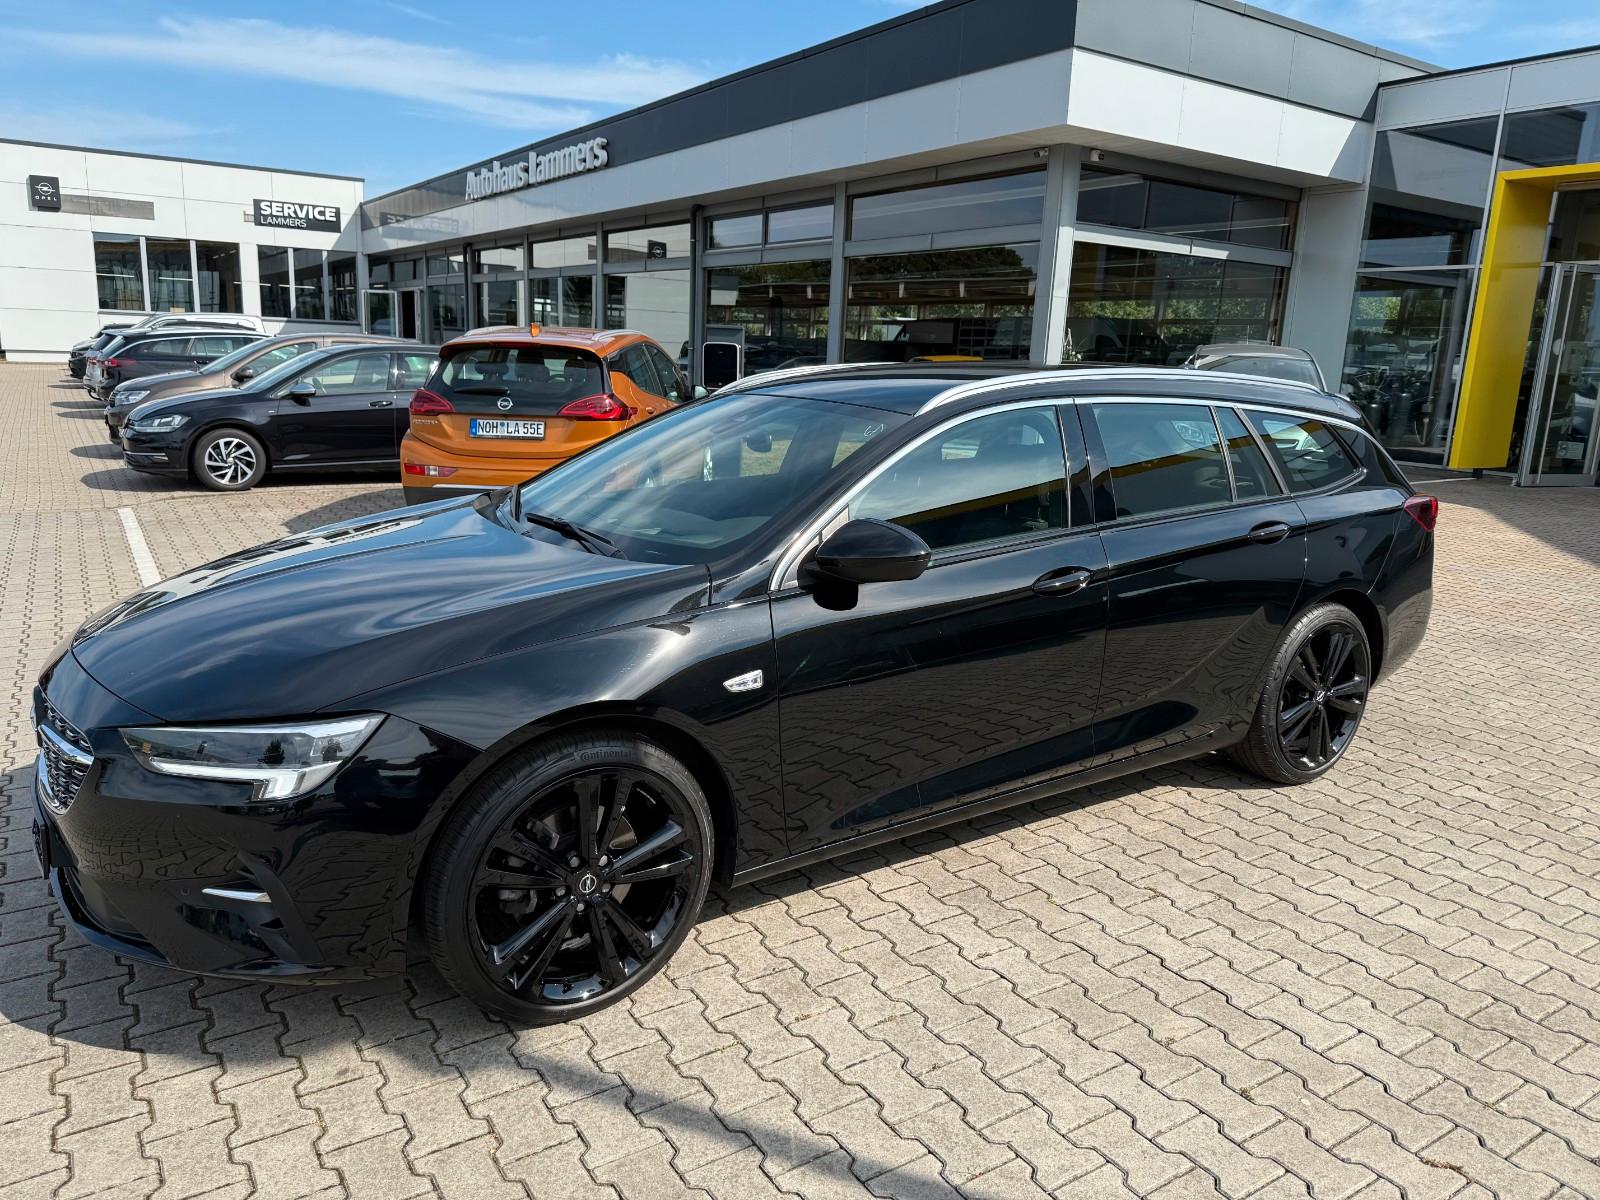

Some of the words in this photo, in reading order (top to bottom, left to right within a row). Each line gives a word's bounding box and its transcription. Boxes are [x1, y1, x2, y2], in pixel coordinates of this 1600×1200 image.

[465, 160, 529, 200] Autohaus
[260, 201, 337, 221] SERVICE
[260, 216, 307, 227] LAMMERS
[477, 421, 499, 434] NOH
[506, 422, 520, 435] LA
[522, 423, 543, 435] 55E
[580, 749, 633, 762] Continental
